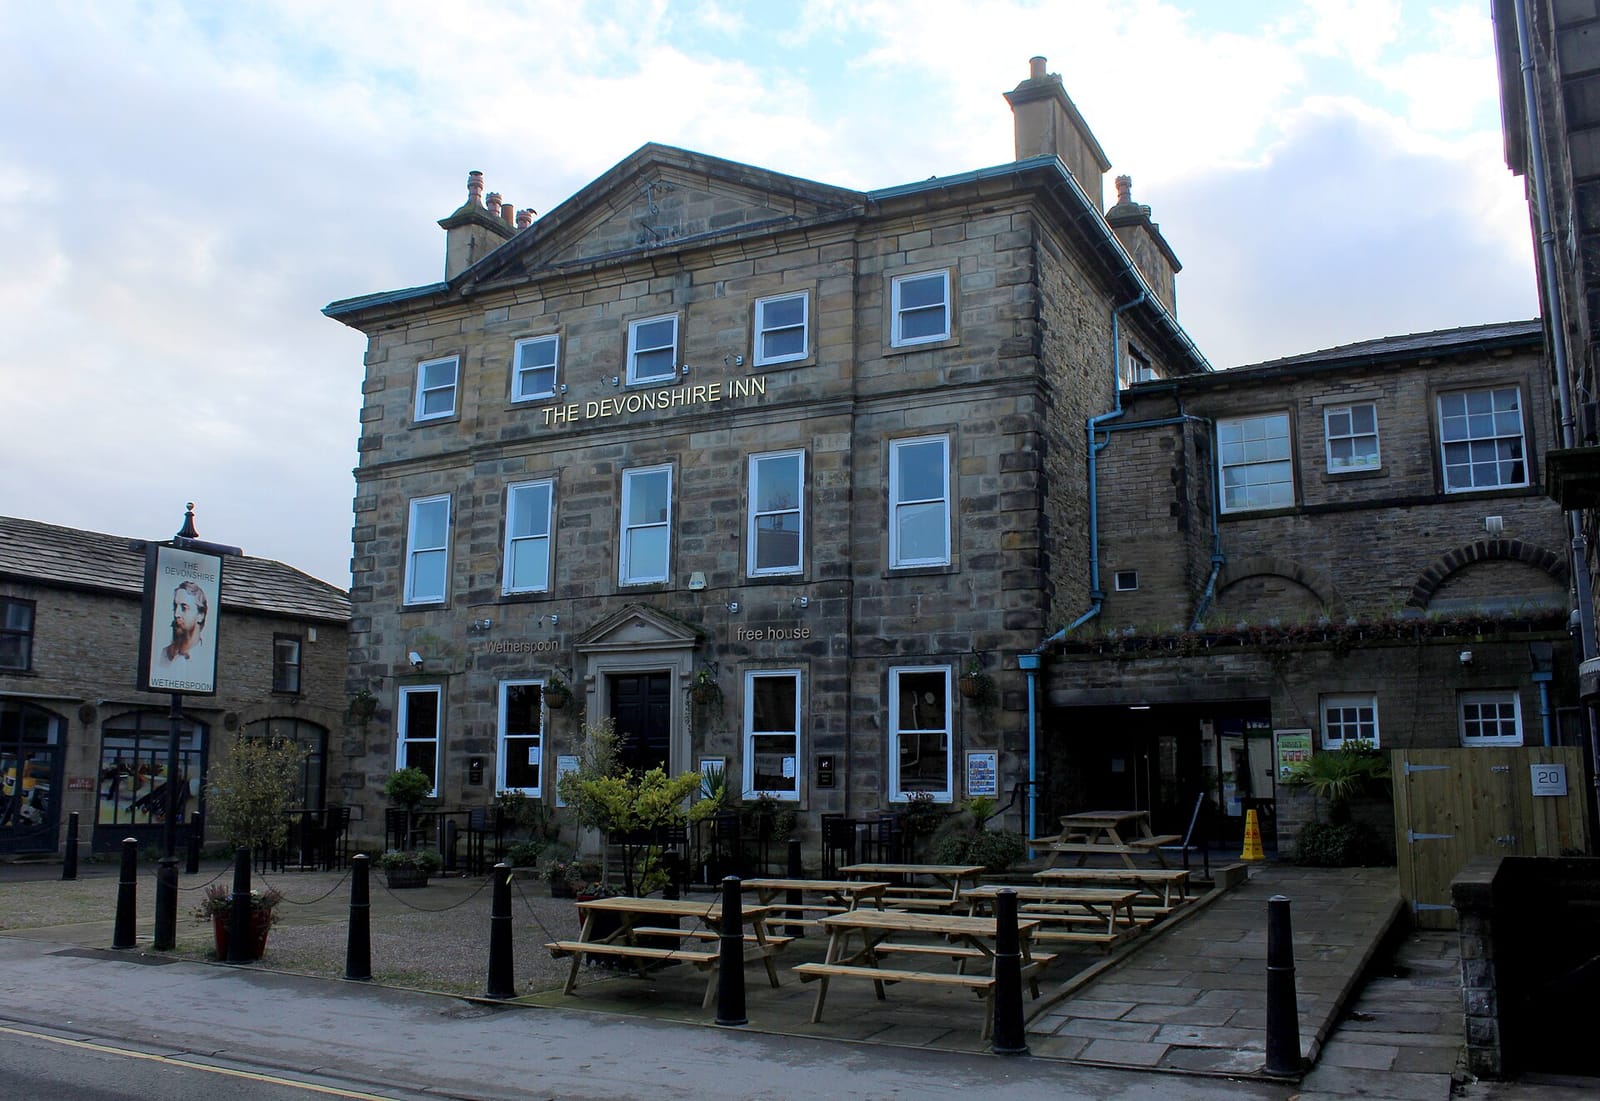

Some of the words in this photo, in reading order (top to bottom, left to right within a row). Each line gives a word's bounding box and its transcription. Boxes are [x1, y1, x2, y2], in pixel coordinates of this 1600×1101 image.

[542, 404, 579, 425] THE
[586, 383, 721, 420] DEVONSHIRE
[728, 376, 767, 399] INN
[183, 561, 199, 571] THE
[165, 566, 215, 583] DEVONSHIRE
[737, 627, 763, 640] free
[768, 626, 810, 640] house
[483, 640, 559, 654] Wetherspoon
[151, 678, 212, 691] WETHERSPOON
[1538, 771, 1559, 784] 20
